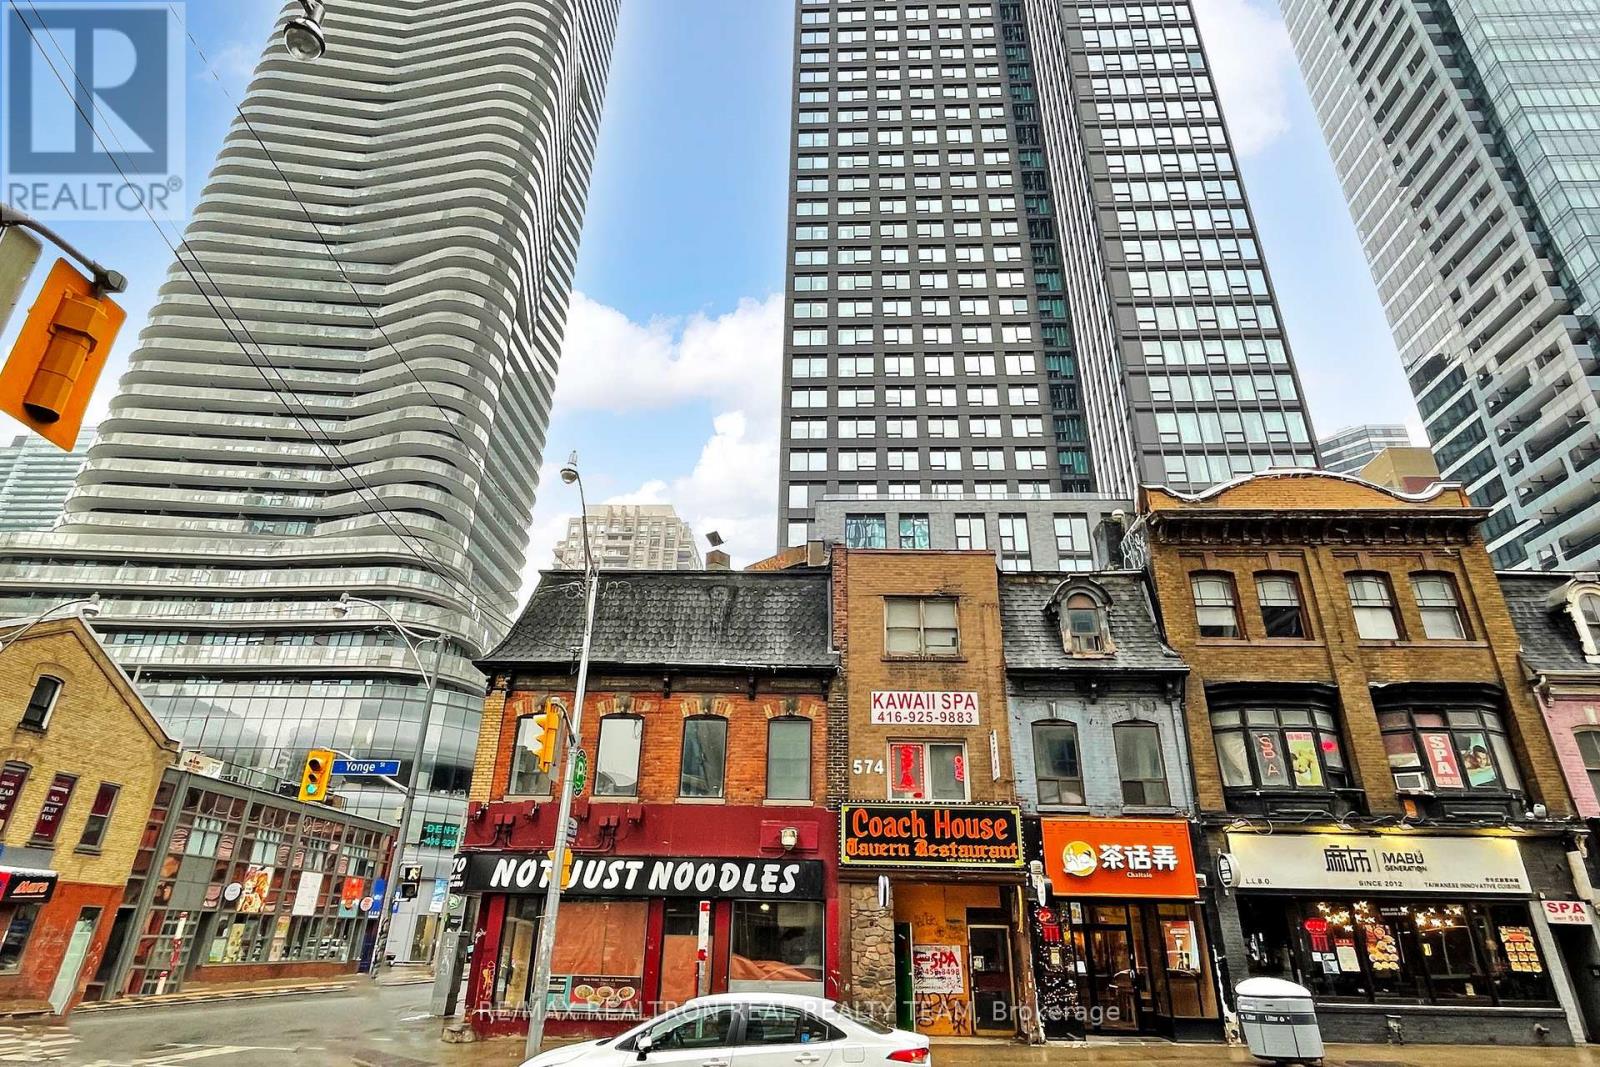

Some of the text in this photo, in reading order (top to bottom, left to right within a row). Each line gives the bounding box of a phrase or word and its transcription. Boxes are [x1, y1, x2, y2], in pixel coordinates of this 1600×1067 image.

[872, 693, 976, 711] KAWAII SPA
[877, 711, 973, 723] 416-925-9883
[1259, 736, 1280, 777] SPA
[1428, 735, 1454, 775] SPA
[346, 761, 376, 772] Yonge
[852, 759, 885, 775] 574
[852, 808, 1009, 840] Coach House
[846, 838, 1018, 860] Tavern Restaurant
[1098, 844, 1179, 871] 茶话弄
[489, 858, 801, 894] NOT JUST NOODLES
[1384, 865, 1428, 873] GENERATION
[1546, 902, 1585, 914] SPA
[930, 950, 959, 969] SPA
